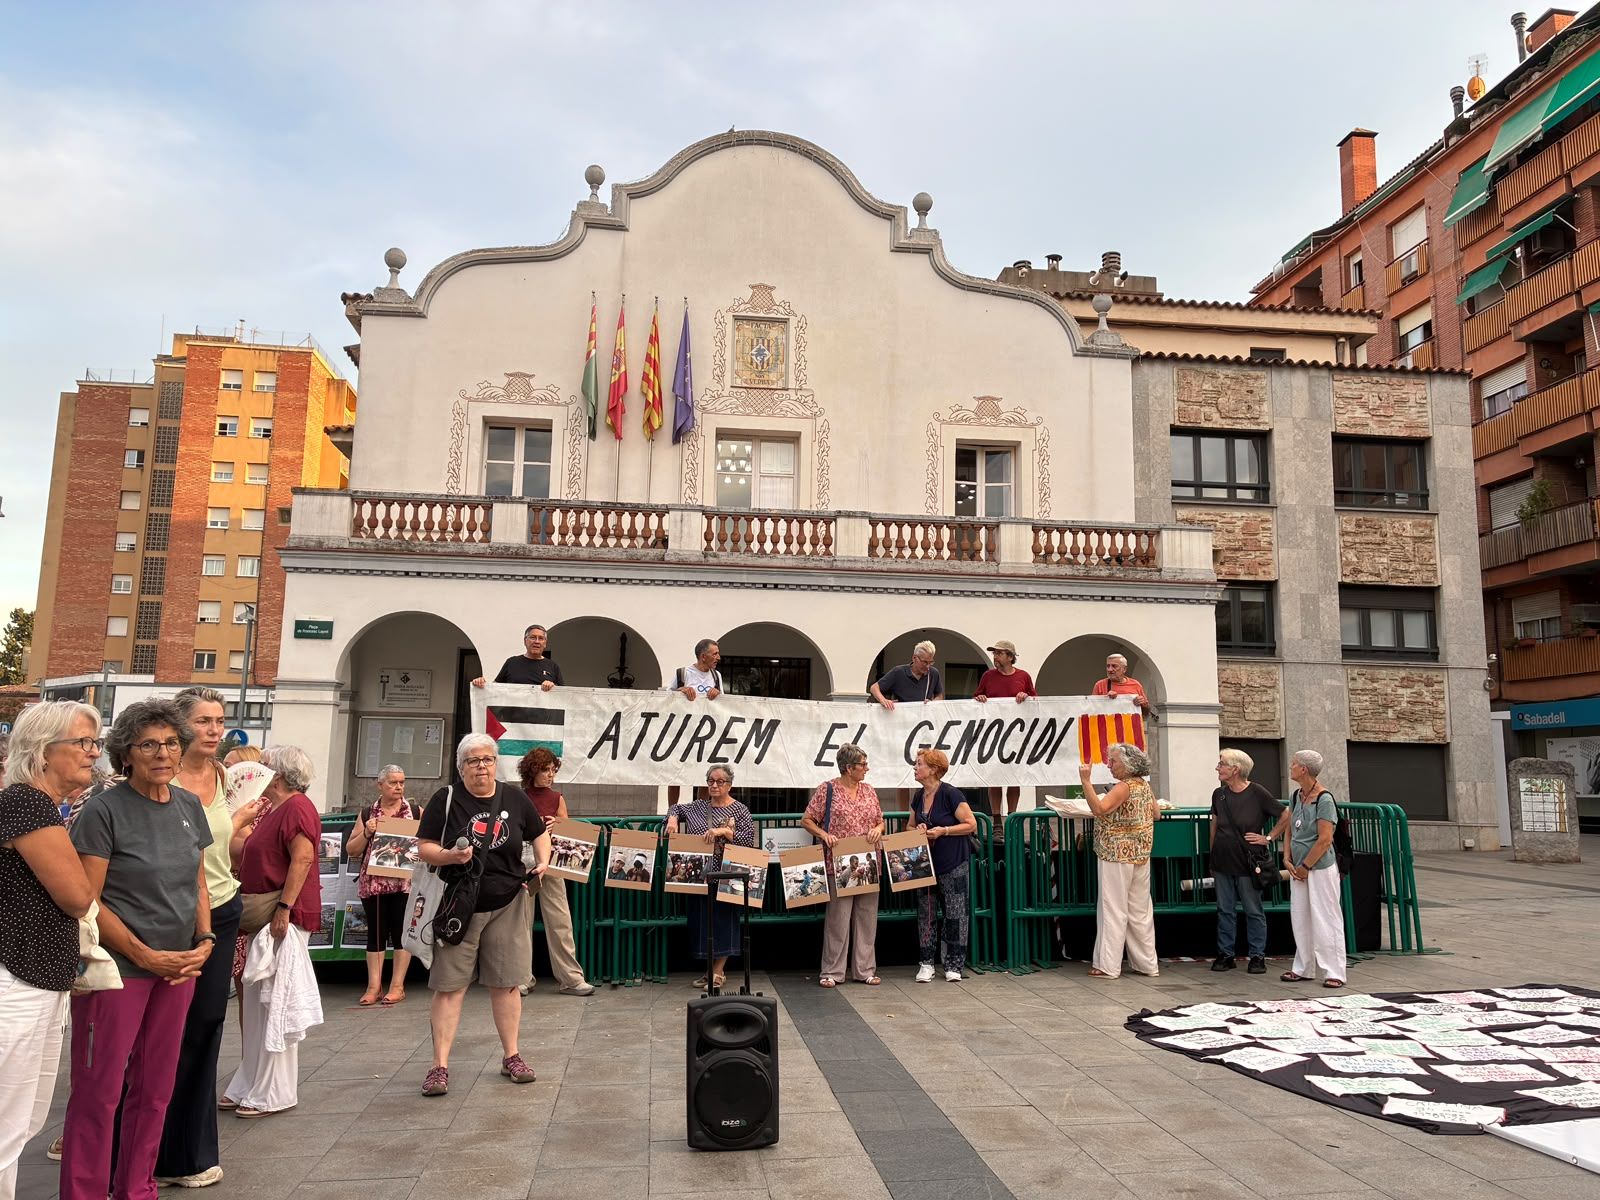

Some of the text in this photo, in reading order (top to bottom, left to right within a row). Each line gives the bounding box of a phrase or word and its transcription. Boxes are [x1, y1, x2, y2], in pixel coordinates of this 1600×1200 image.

[1524, 711, 1566, 725] Sabadell
[588, 711, 782, 765] ATUREM
[903, 717, 1075, 766] GENOCIDI
